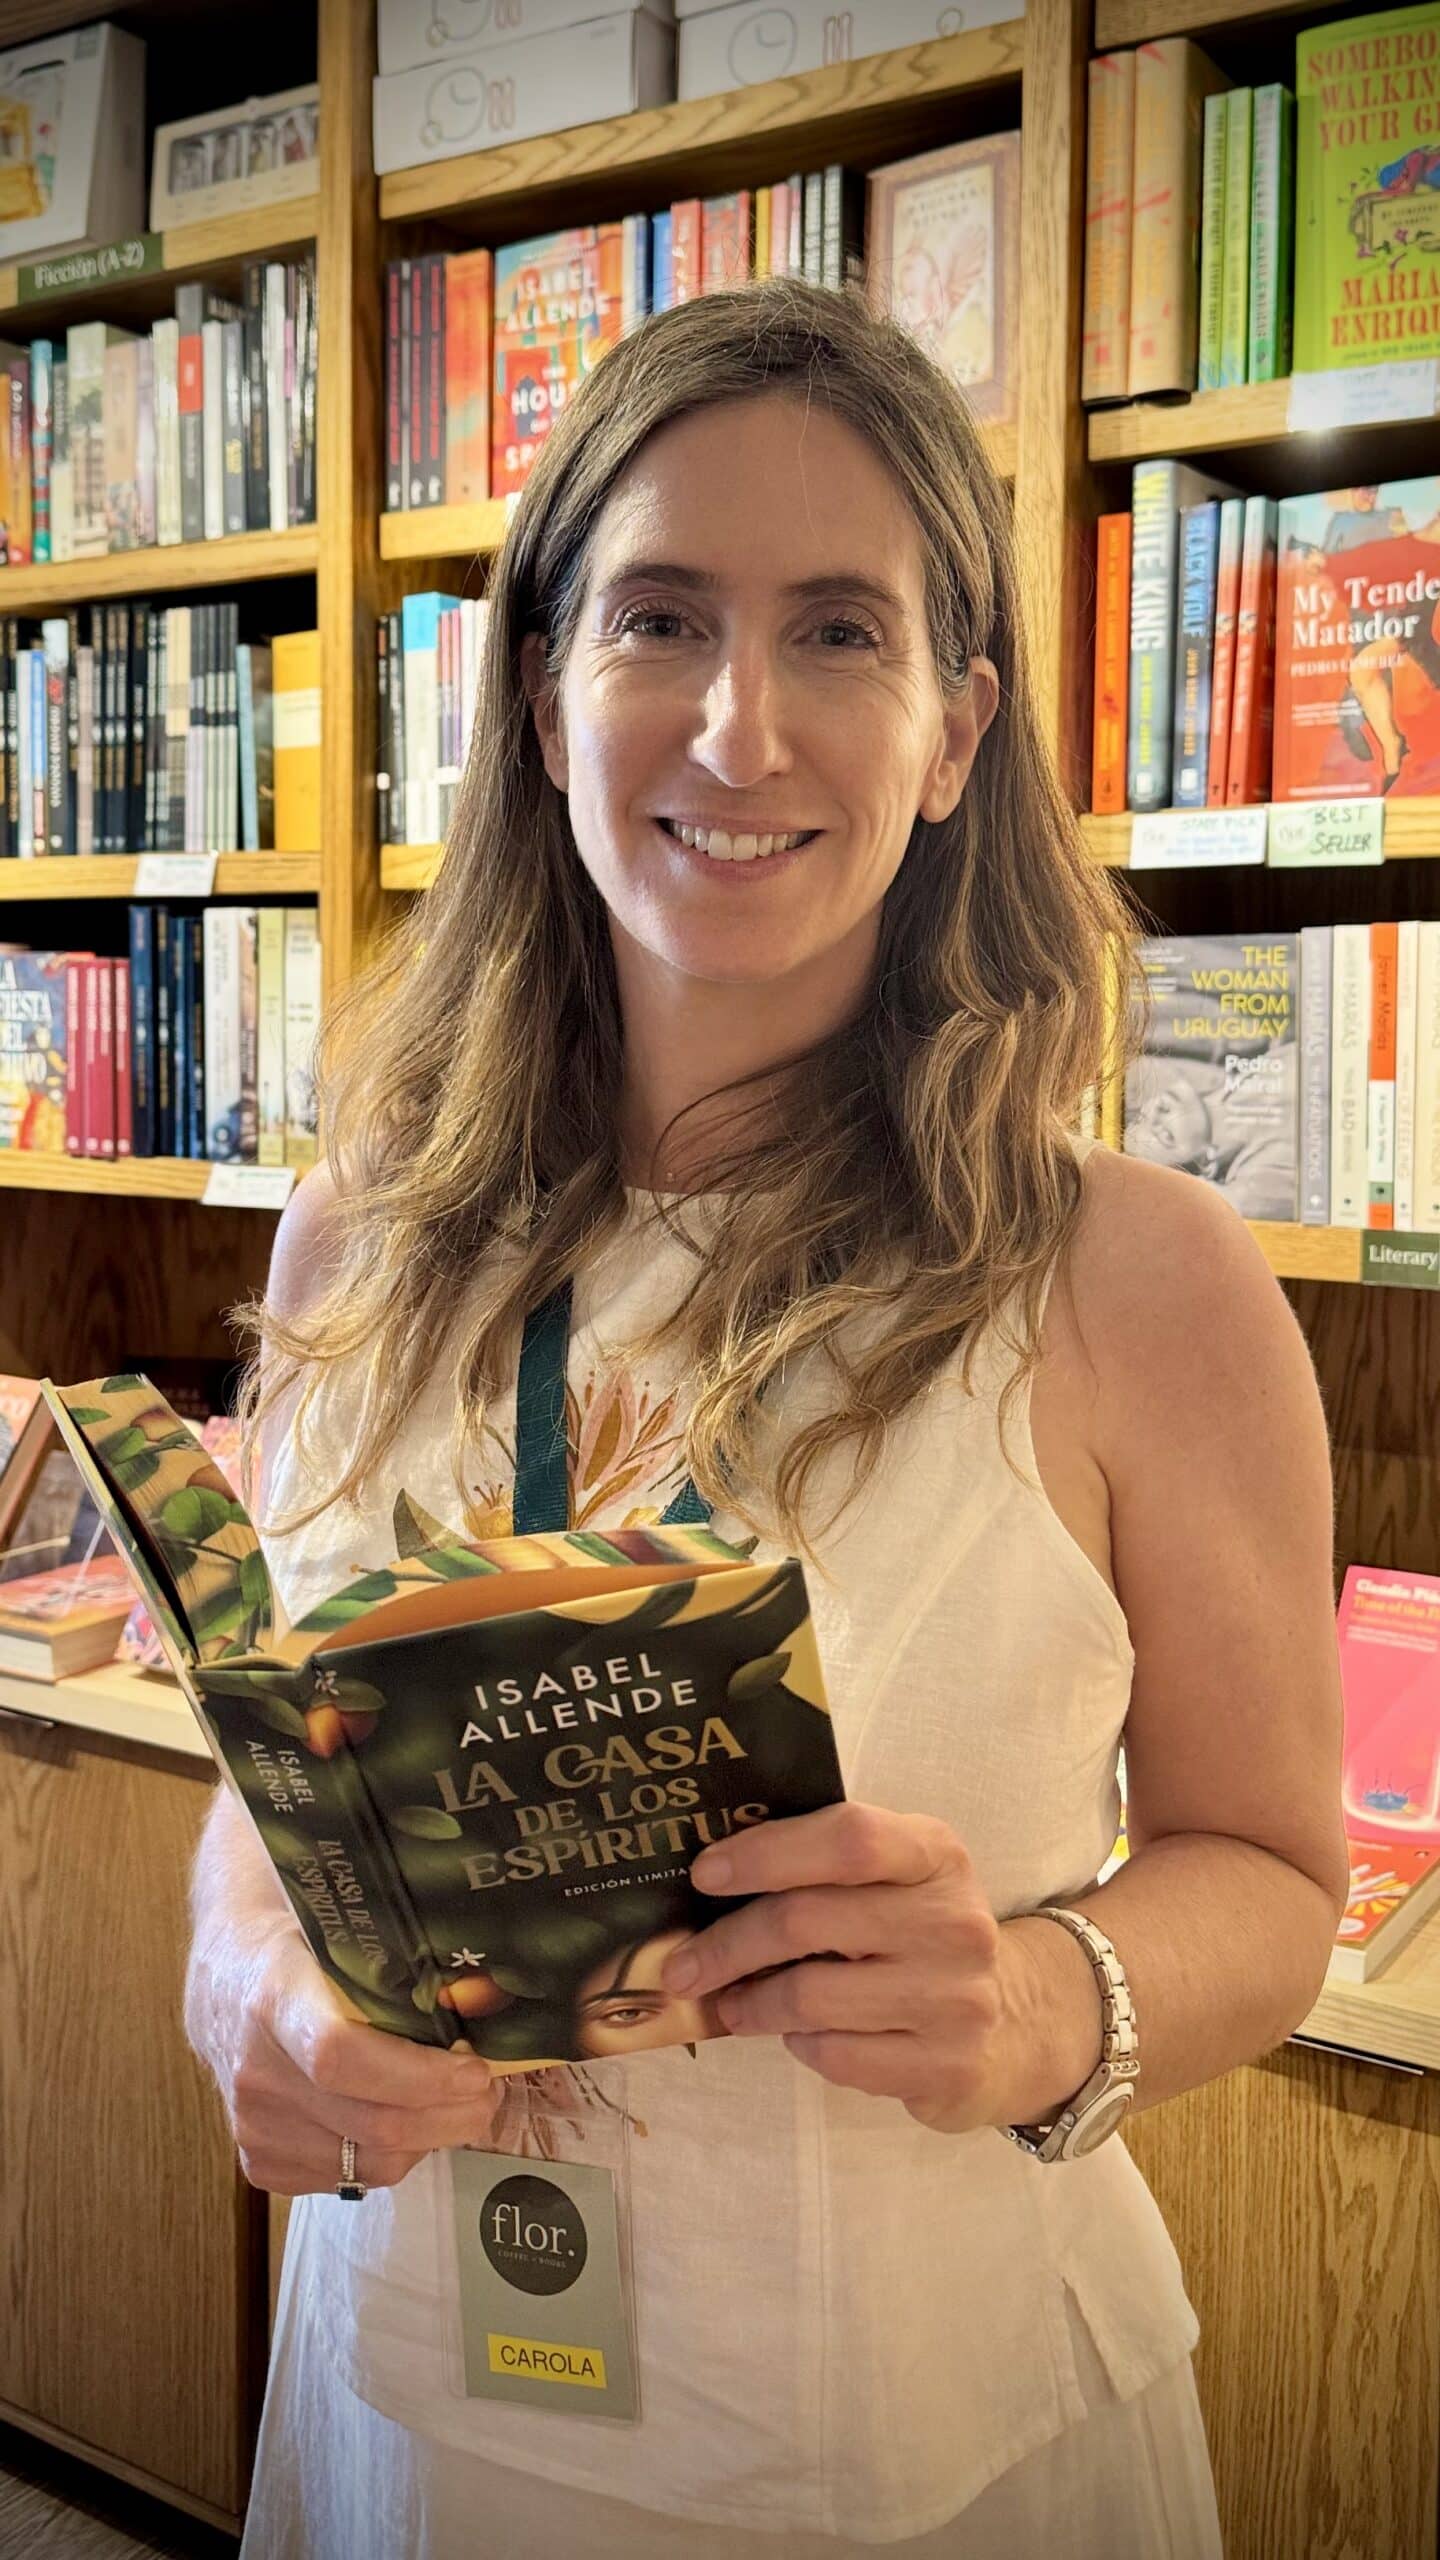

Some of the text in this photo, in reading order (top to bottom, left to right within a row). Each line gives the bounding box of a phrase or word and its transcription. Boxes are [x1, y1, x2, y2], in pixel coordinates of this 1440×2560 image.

[1307, 29, 1438, 84] SOMEBO
[1319, 101, 1440, 151] YOUR G
[517, 262, 599, 299] ISABEL
[506, 292, 611, 333] ALLENDE
[511, 380, 579, 417] HOU
[1133, 470, 1169, 572] WHITE
[1186, 516, 1210, 579] BLACK
[1131, 577, 1168, 651] KING
[1183, 582, 1208, 638] WOLF
[1293, 569, 1440, 622] My Tende
[1292, 609, 1420, 650] Matador
[1311, 805, 1368, 825] BEST
[1308, 830, 1372, 856] SELLER
[1241, 945, 1289, 967] THE
[1191, 968, 1289, 991] WOMAN
[1219, 992, 1289, 1016] FROM
[1172, 1016, 1289, 1040] URUGUAY
[1224, 1053, 1284, 1075] Pedro
[1368, 1244, 1439, 1272] Literary
[474, 1652, 662, 1711] ISABEL
[459, 1679, 697, 1748] ALLENDE
[245, 1739, 295, 1815] ALLENDE
[277, 1749, 316, 1805] ISABEL
[432, 1716, 749, 1813] LA CASA
[514, 1776, 702, 1838] DE LOS
[317, 1838, 345, 1858] LA
[326, 1858, 364, 1905] CASA
[564, 1866, 689, 1897] EDICIÓN LIMITA
[346, 1908, 376, 1934] DE
[491, 2203, 575, 2257] flor.
[500, 2344, 597, 2379] CAROLA
